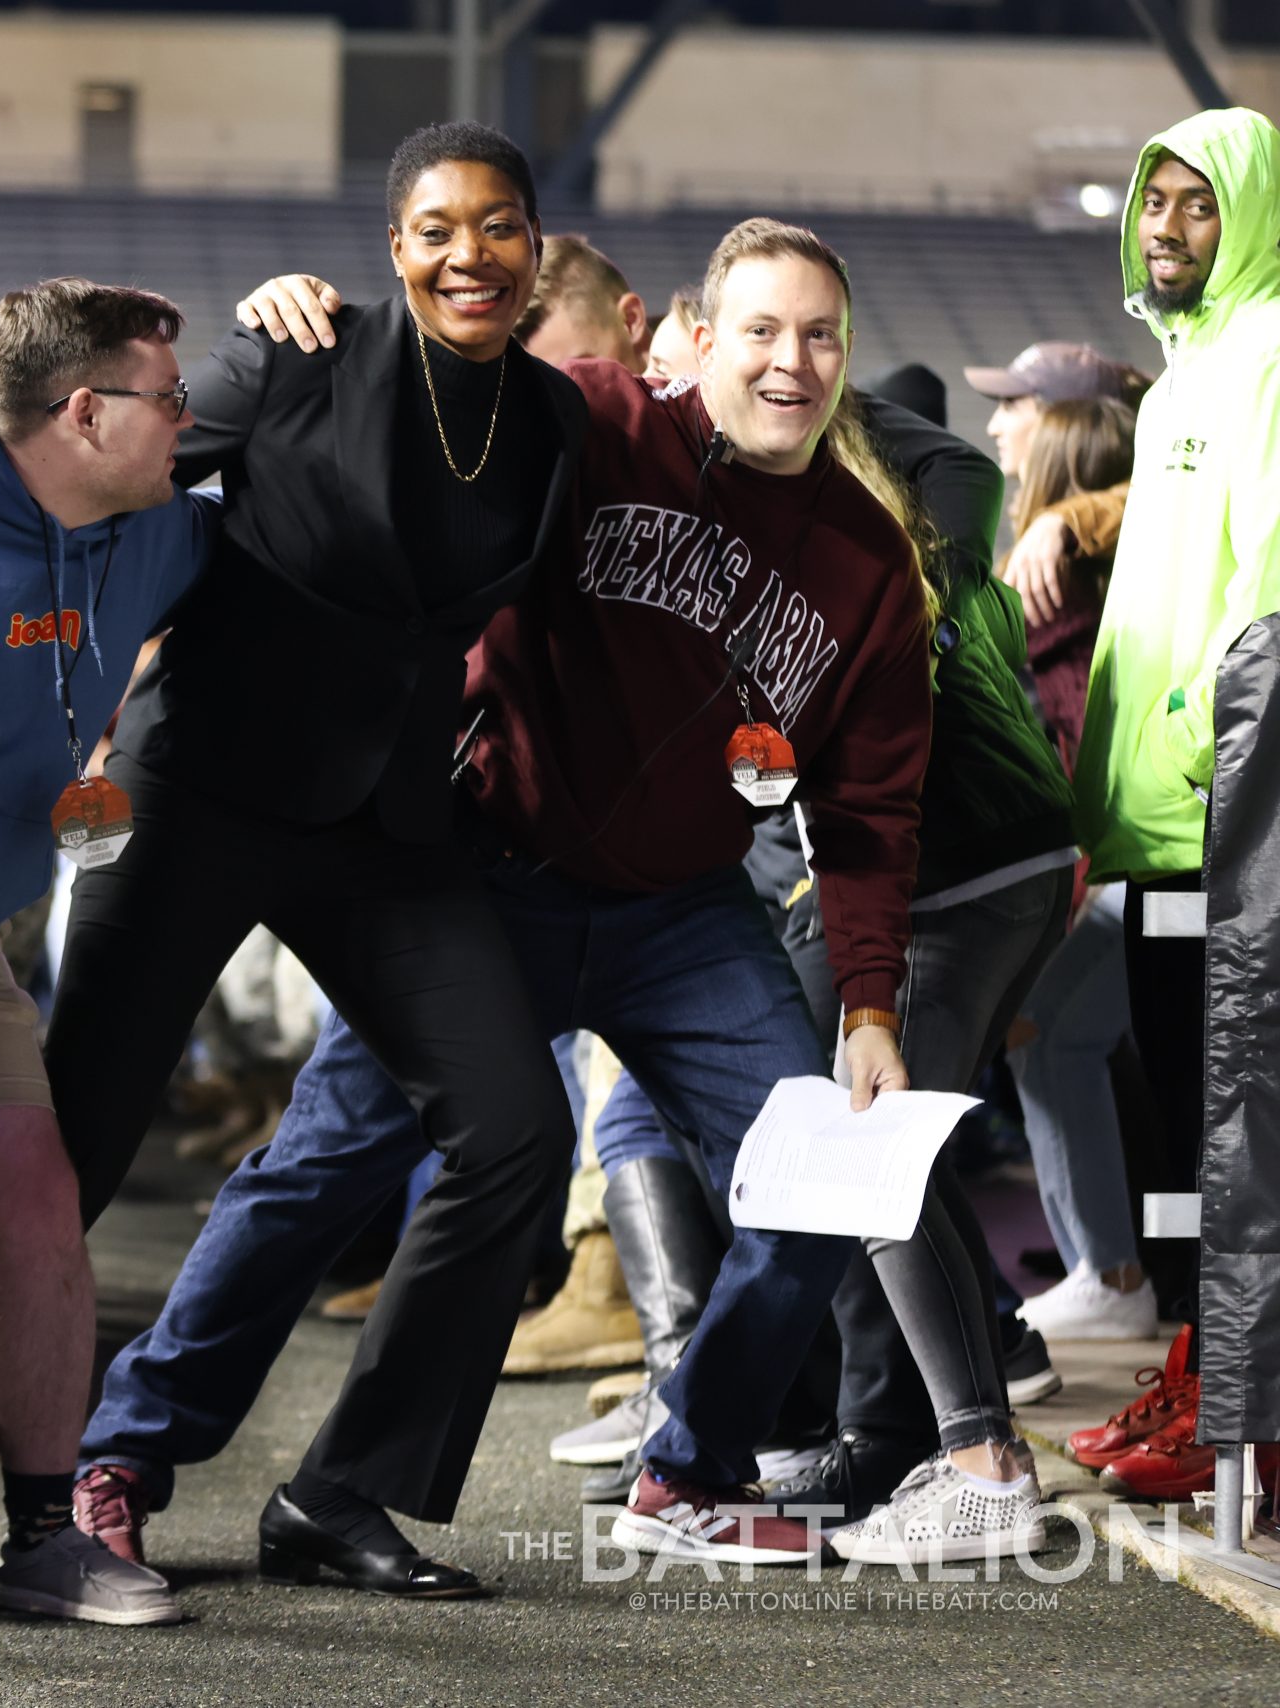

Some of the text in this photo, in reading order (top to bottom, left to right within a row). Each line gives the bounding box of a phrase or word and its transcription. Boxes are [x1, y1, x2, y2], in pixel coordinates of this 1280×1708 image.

[5, 609, 81, 651] joan
[578, 504, 838, 737] TEXAS A&M
[64, 832, 86, 843] YELL
